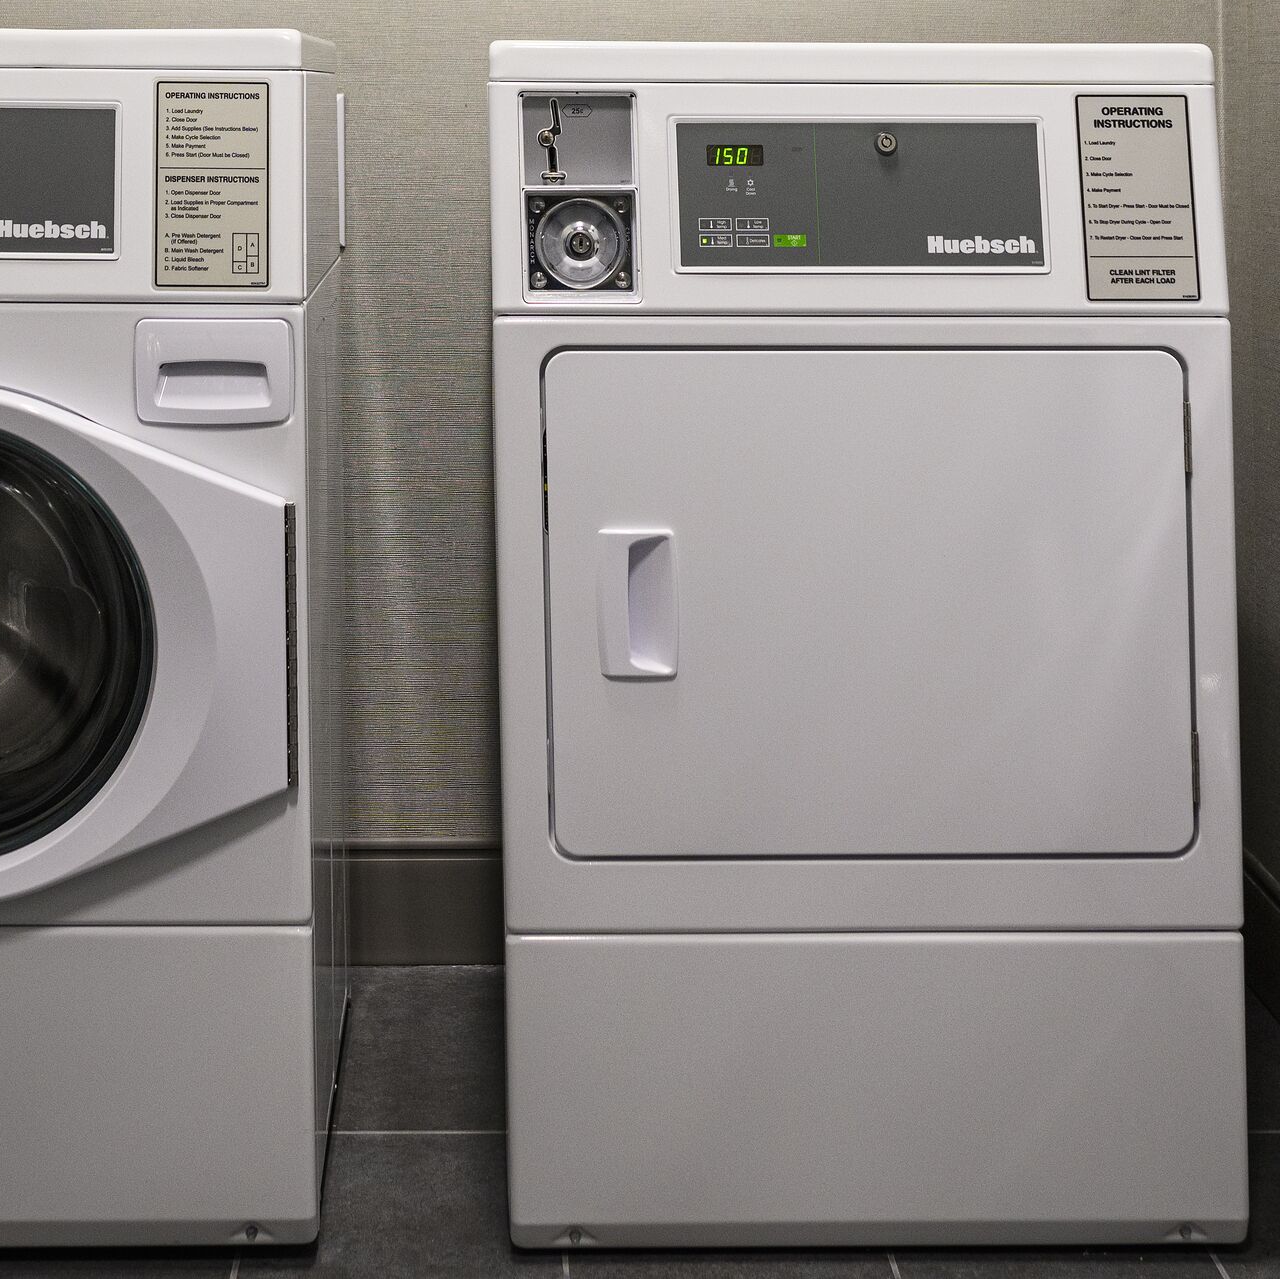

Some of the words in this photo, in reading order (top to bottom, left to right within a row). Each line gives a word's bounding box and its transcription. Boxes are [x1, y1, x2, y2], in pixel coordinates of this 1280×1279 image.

[208, 92, 260, 100] INSTRUCTIONS
[1102, 107, 1163, 116] OPERATING
[1094, 120, 1173, 128] INSTRUCTIONS
[716, 148, 748, 165] 150
[927, 236, 1035, 253] Huebsch
